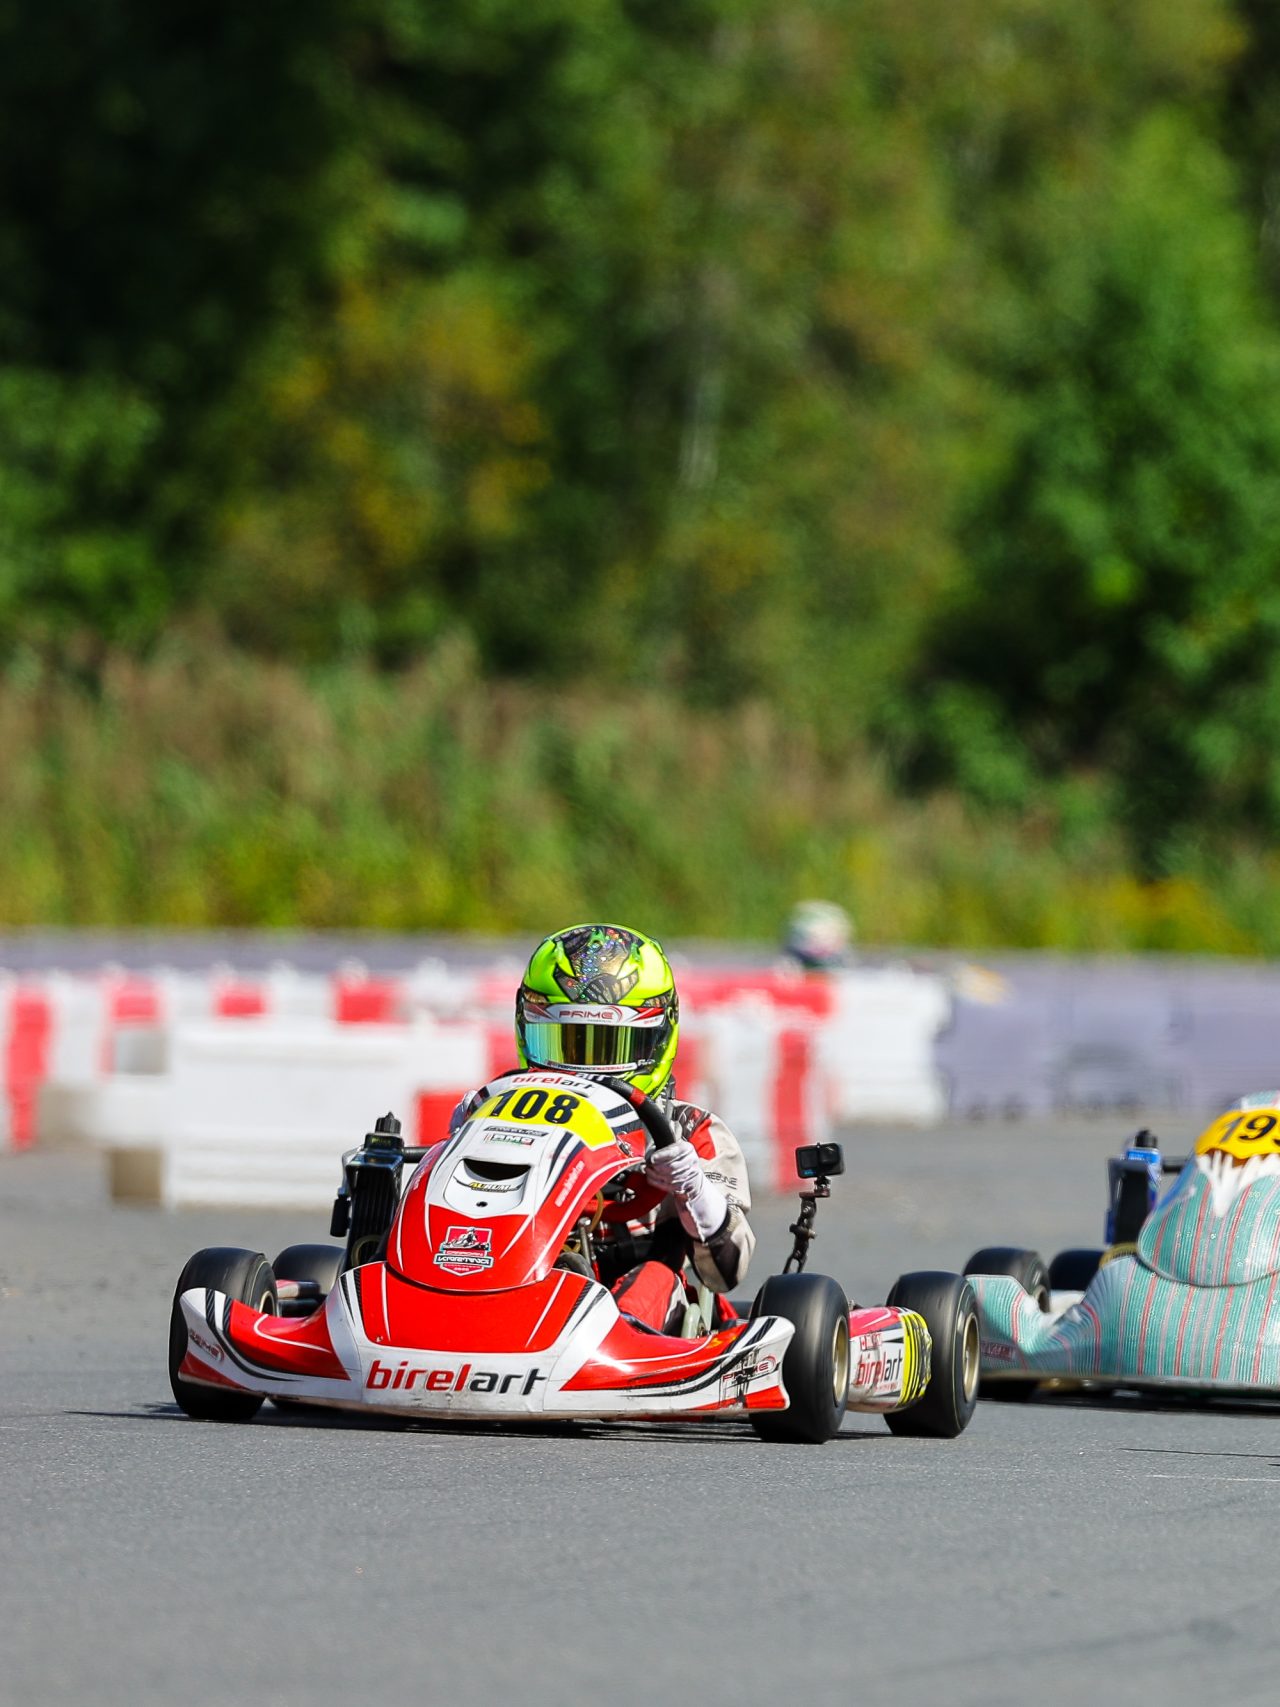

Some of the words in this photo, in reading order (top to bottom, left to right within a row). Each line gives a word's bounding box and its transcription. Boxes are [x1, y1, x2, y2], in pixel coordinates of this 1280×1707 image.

[559, 1010, 613, 1020] PRIME
[511, 1075, 595, 1090] birelart
[488, 1089, 581, 1125] 108
[366, 1360, 547, 1396] birelart
